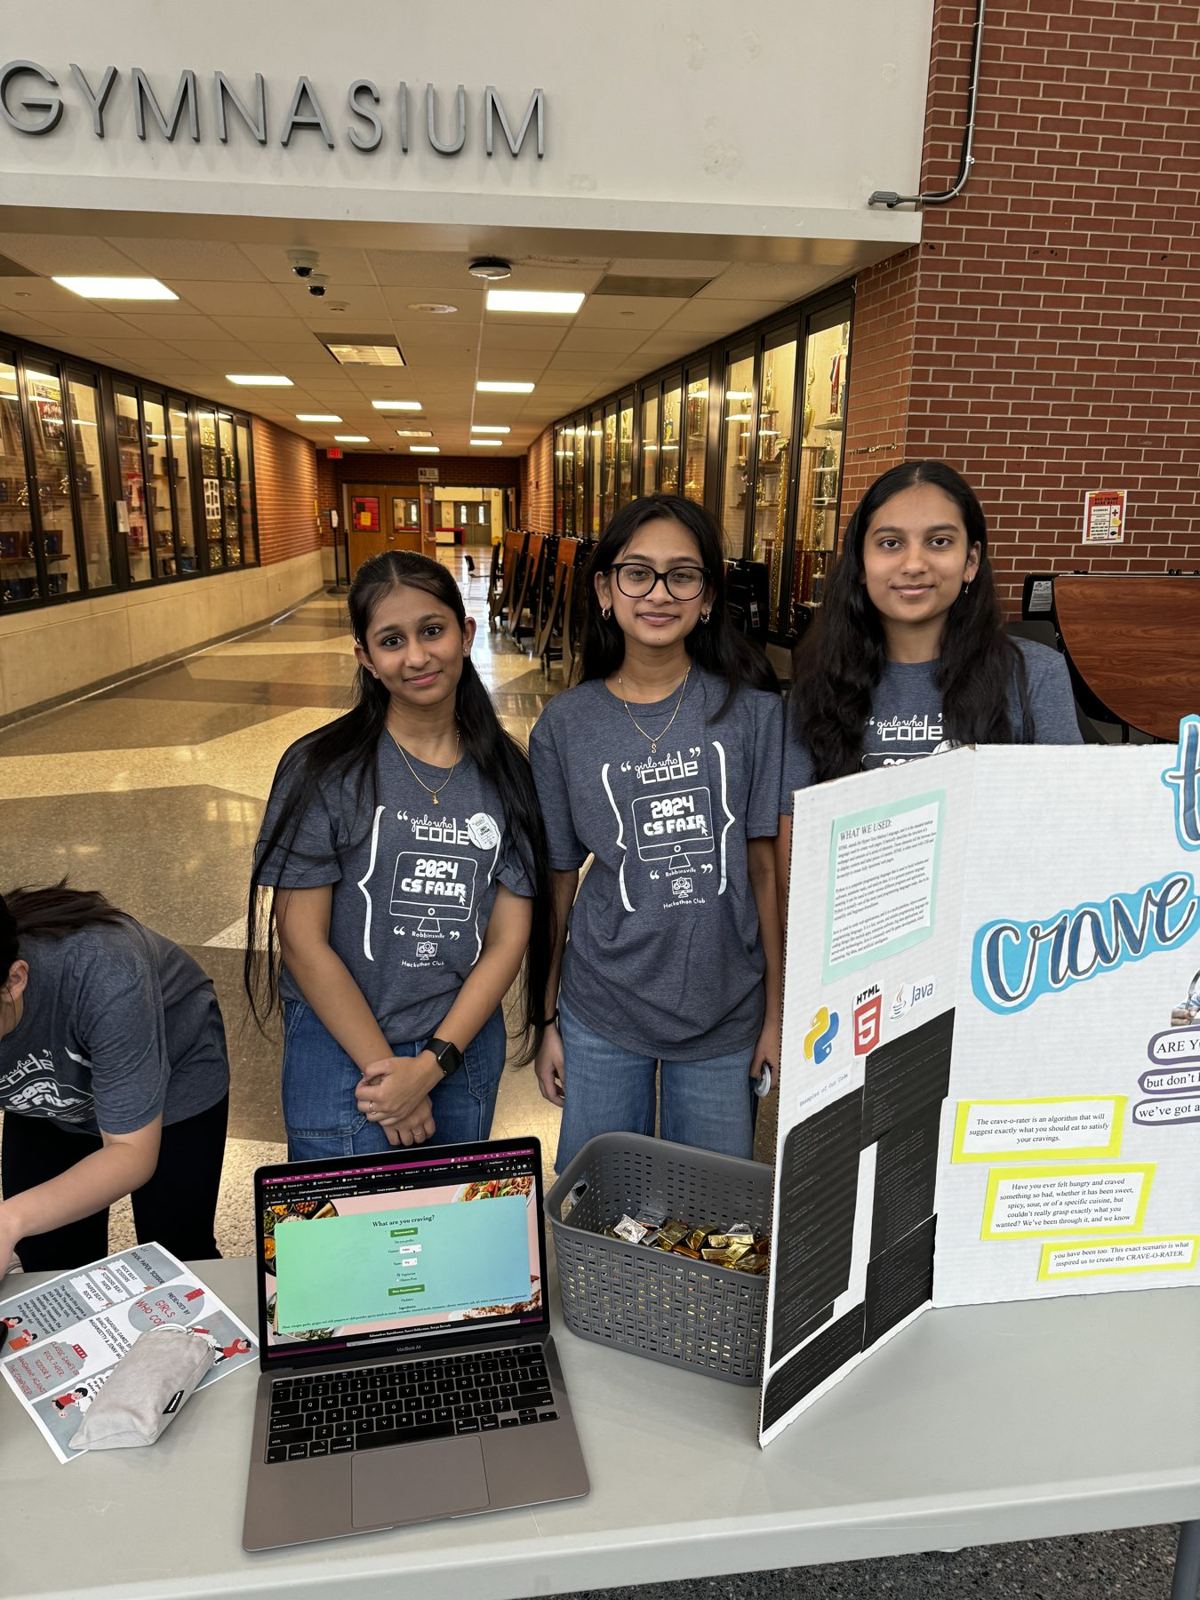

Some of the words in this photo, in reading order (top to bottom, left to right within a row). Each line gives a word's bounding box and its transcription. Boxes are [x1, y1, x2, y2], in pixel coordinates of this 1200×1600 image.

[0, 59, 546, 159] GYMNASIUM
[877, 715, 901, 735] girls
[901, 714, 923, 727] who
[635, 756, 657, 779] girls
[657, 753, 678, 767] who
[650, 795, 695, 819] 2024
[410, 814, 432, 833] girls
[432, 816, 453, 829] who
[643, 820, 664, 836] CS
[666, 814, 707, 834] FAIR
[840, 827, 860, 841] WHAT
[862, 825, 872, 834] WE
[414, 858, 459, 880] 2024
[401, 878, 423, 894] CS
[424, 881, 466, 899] FAIR
[985, 877, 1196, 1003] crave
[856, 983, 880, 1005] HTML
[910, 981, 934, 1007] Java
[1156, 1040, 1185, 1054] ARE
[1189, 1039, 1200, 1050] Y
[1146, 1078, 1163, 1088] but
[1166, 1073, 1195, 1086] don't
[1047, 1114, 1078, 1123] algorithm
[1139, 1106, 1171, 1118] we've
[1174, 1104, 1191, 1117] got
[994, 1127, 1017, 1135] exactly
[1089, 1123, 1109, 1131] satisfy
[1016, 1136, 1031, 1144] your
[1069, 1180, 1090, 1188] hungry
[999, 1192, 1031, 1201] something
[1056, 1189, 1080, 1197] whether
[1064, 1199, 1088, 1207] specific
[411, 1214, 435, 1223] craving?
[1007, 1210, 1033, 1218] couldn't
[1033, 1209, 1052, 1217] really
[1052, 1209, 1070, 1217] grasp
[1070, 1207, 1092, 1215] exactly
[1109, 1206, 1122, 1214] you
[1022, 1219, 1042, 1227] We've
[1043, 1218, 1058, 1226] been
[1058, 1217, 1082, 1225] through
[1055, 1259, 1080, 1267] inspired
[134, 1299, 153, 1314] WHO
[154, 1299, 176, 1318] GIRLS
